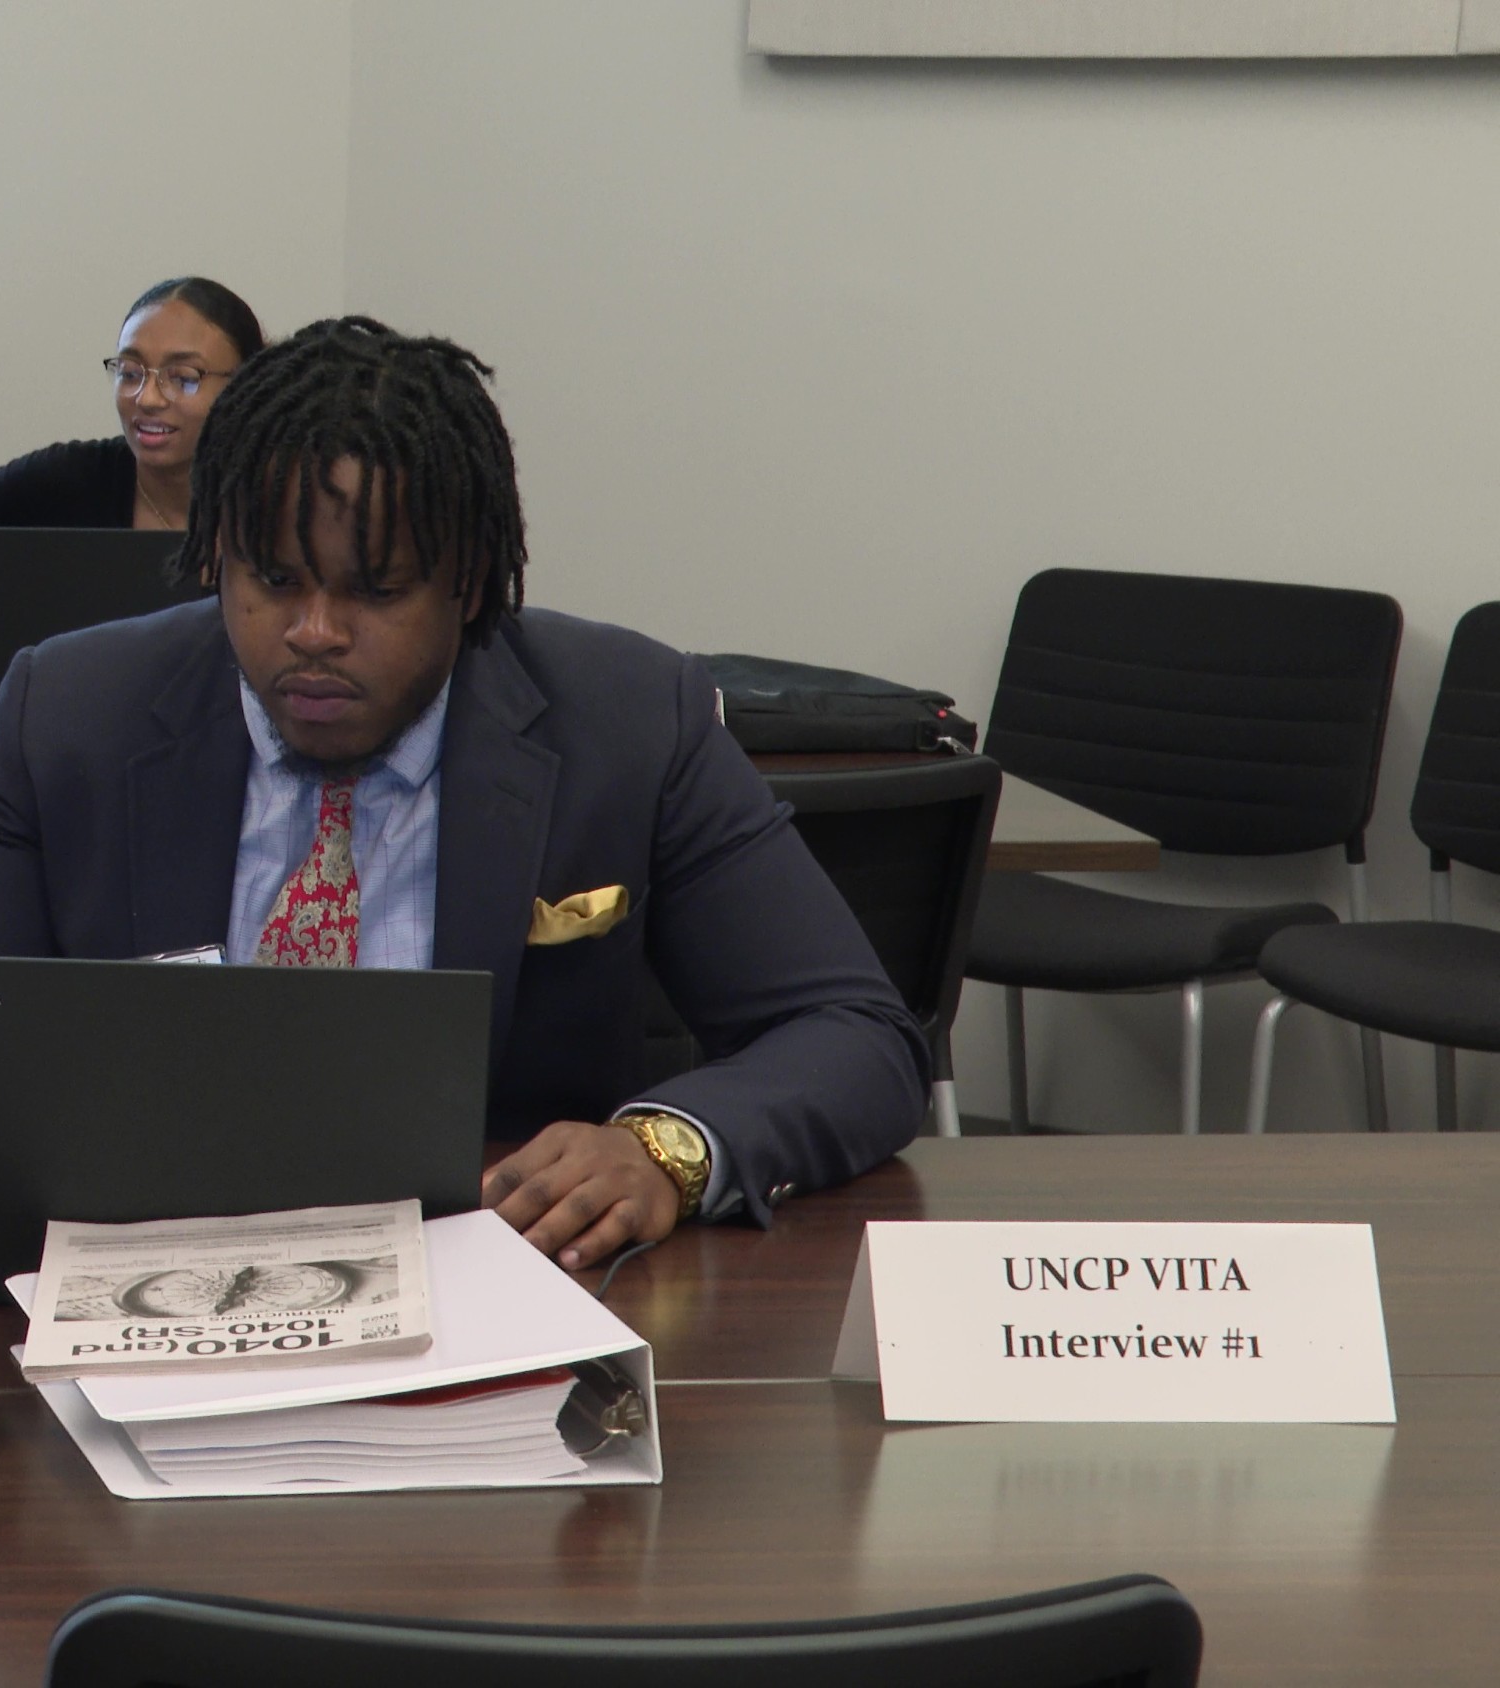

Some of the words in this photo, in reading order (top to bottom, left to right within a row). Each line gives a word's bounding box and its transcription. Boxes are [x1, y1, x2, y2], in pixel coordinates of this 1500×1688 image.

[1001, 1256, 1130, 1291] UNCP
[1140, 1256, 1251, 1291] VITA
[208, 1308, 346, 1322] INSTRUCTIONS
[121, 1318, 338, 1340] 1040-SR)
[71, 1339, 178, 1356] (and
[186, 1332, 343, 1356] 1040
[1001, 1324, 1208, 1358] Interview
[1222, 1327, 1263, 1358] #1
